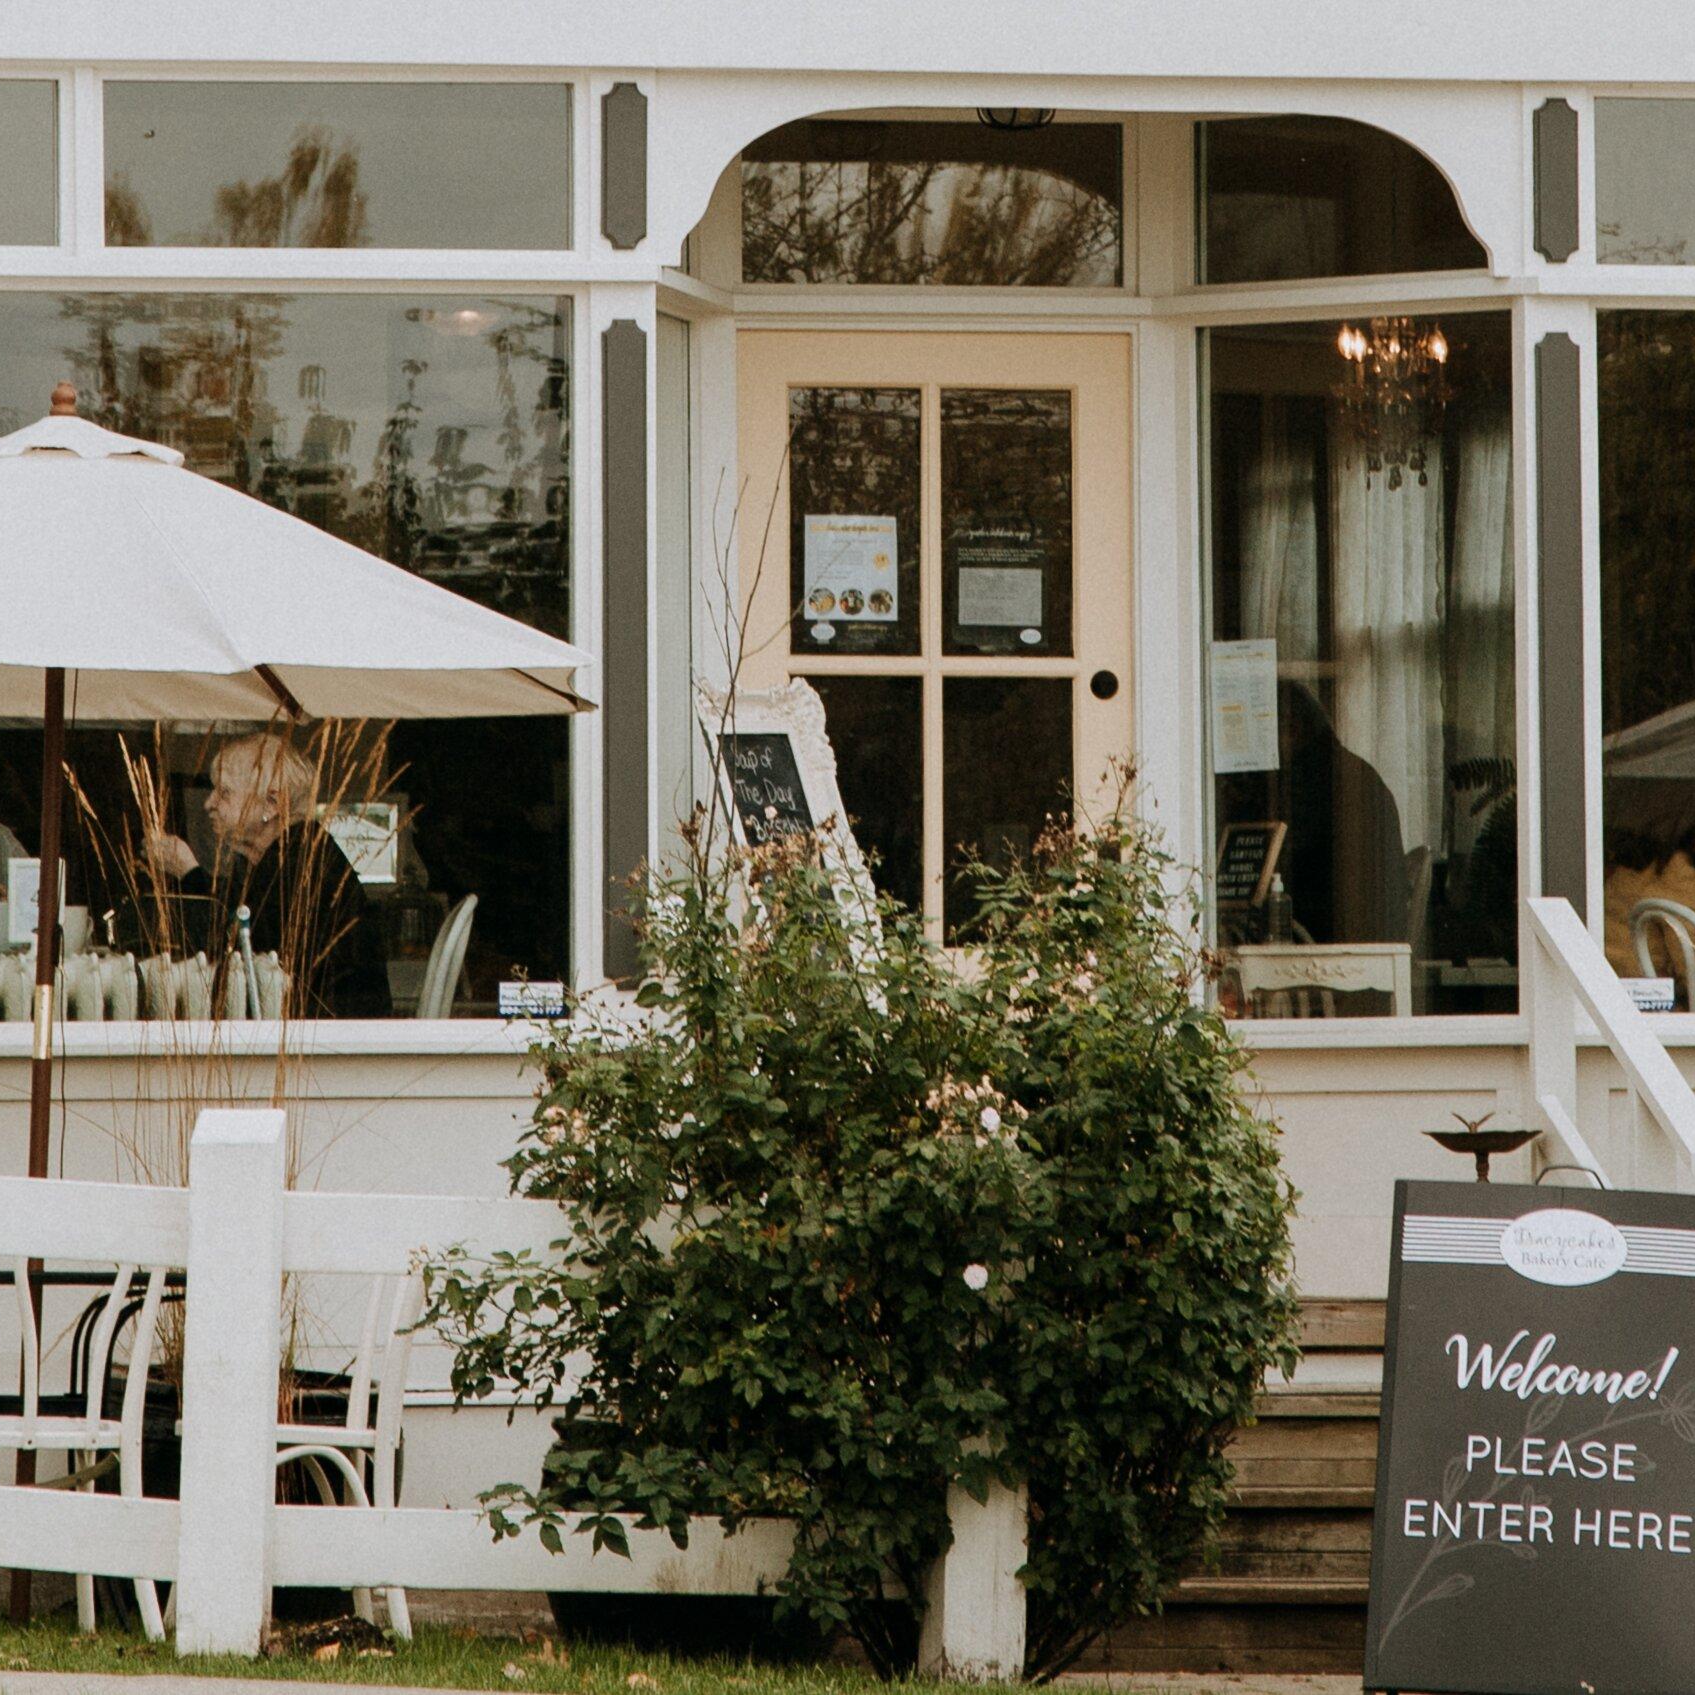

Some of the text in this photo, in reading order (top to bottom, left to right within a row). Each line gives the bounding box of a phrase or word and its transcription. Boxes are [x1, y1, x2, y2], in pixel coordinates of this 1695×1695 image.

[734, 777, 798, 812] The Day
[1521, 1251, 1569, 1267] Bakery
[1445, 1329, 1679, 1404] Welcome!
[1465, 1434, 1638, 1483] PLEASE
[1403, 1498, 1694, 1555] ENTER HERE
